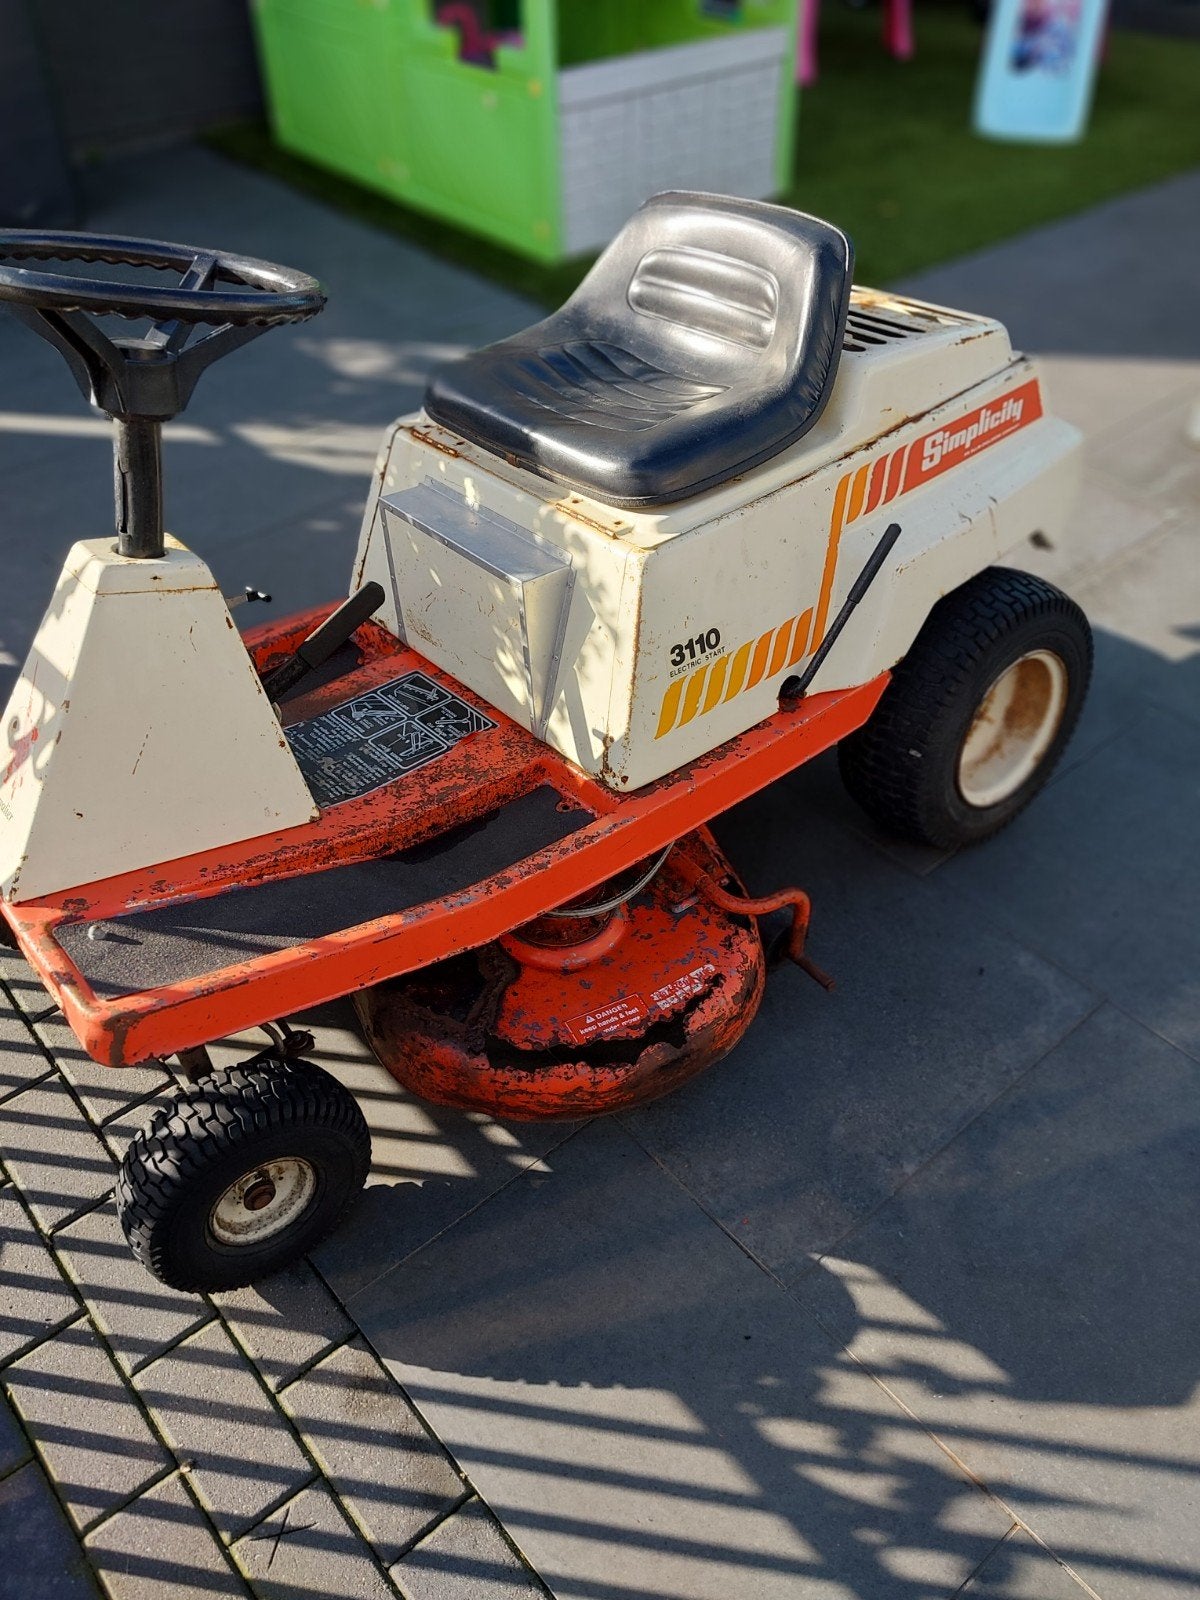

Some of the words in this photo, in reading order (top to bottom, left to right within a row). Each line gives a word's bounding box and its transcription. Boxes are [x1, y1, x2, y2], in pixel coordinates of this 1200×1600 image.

[922, 398, 1023, 472] Simplicity
[669, 658, 702, 678] ELECTRIC
[704, 645, 726, 661] START
[670, 628, 721, 667] 3110
[579, 1024, 598, 1035] keep
[597, 1015, 619, 1028] hands
[625, 1006, 639, 1017] feet
[595, 1003, 628, 1020] DANGER
